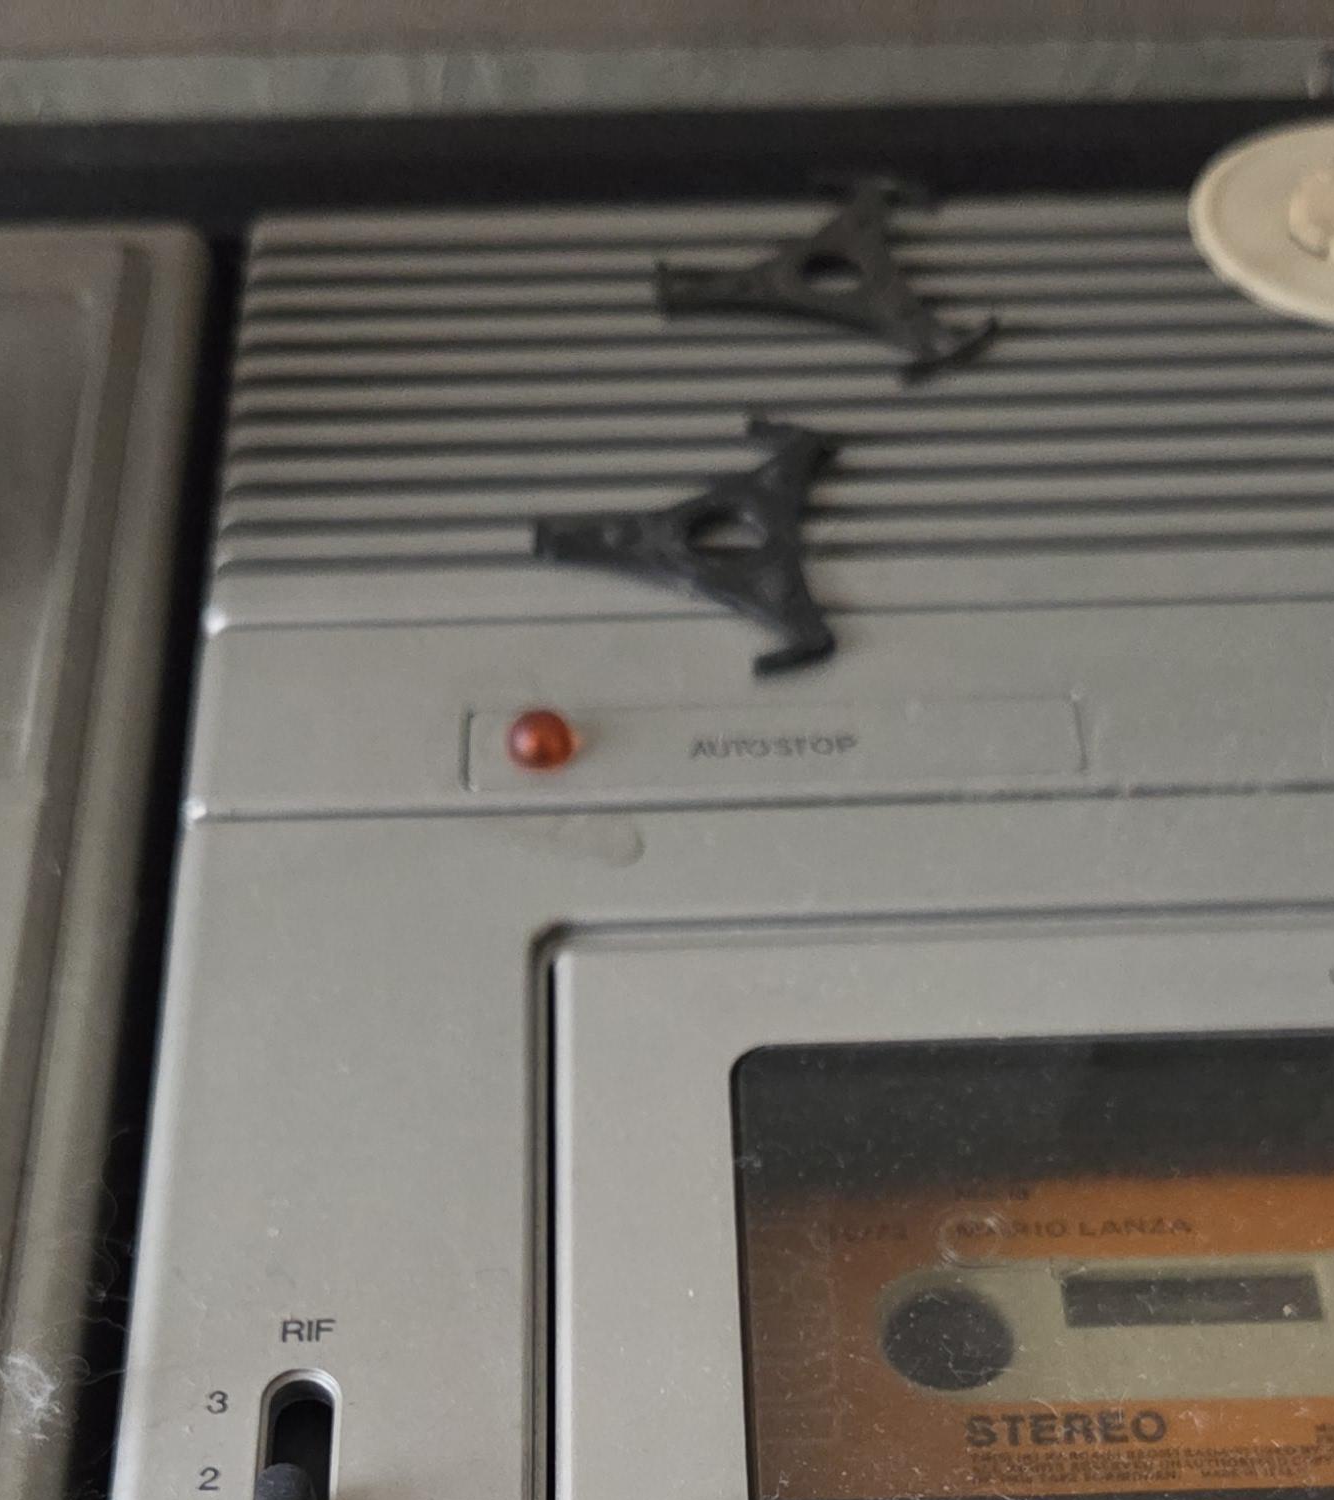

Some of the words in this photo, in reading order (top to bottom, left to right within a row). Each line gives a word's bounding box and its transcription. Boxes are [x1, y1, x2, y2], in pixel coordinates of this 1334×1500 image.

[692, 734, 859, 760] AUTOSTOP
[1077, 1214, 1194, 1238] LANZA
[280, 1318, 336, 1343] RIF
[206, 1390, 229, 1414] 3
[965, 1408, 1167, 1448] STEREO
[197, 1466, 221, 1491] 2
